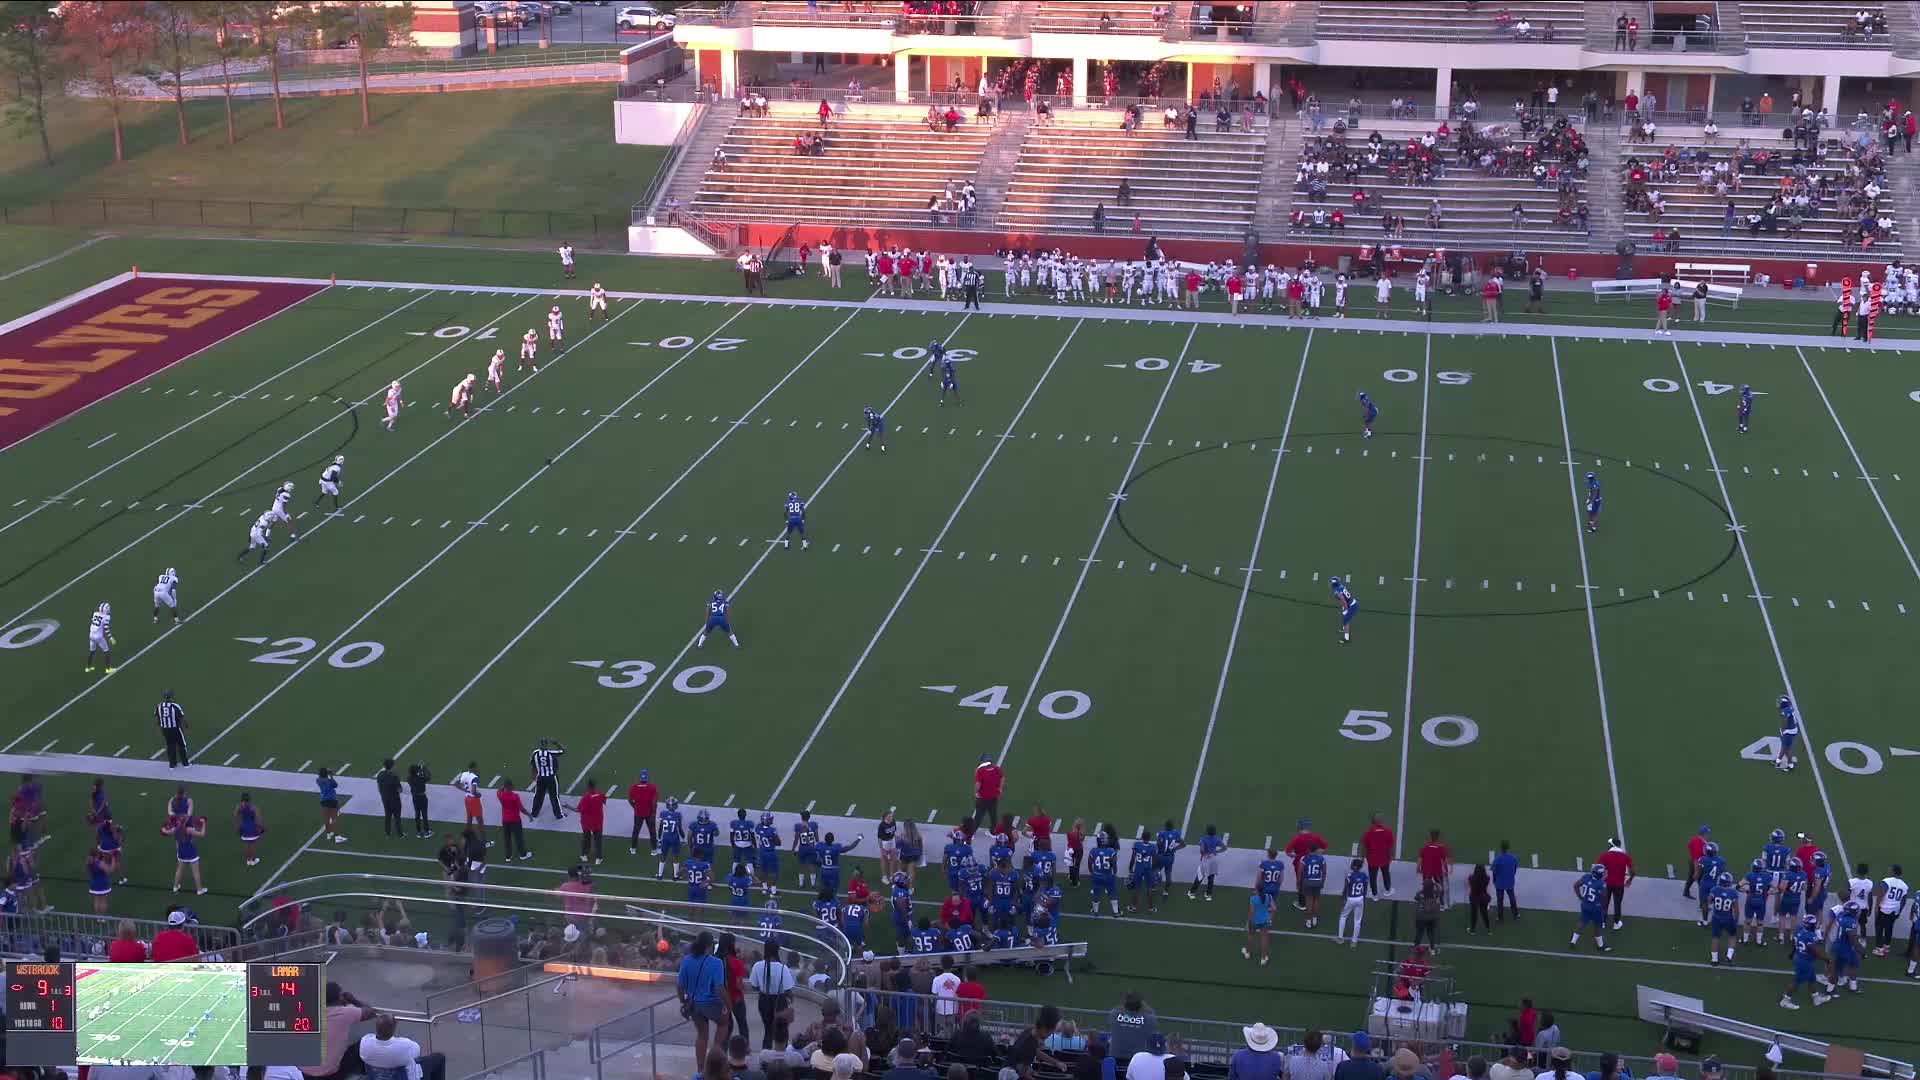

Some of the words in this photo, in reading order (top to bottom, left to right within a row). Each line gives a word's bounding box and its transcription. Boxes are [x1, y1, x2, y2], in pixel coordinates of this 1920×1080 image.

[0, 287, 261, 416] OLVES
[788, 502, 800, 513] 28
[711, 602, 725, 614] 54
[163, 707, 170, 717] B
[1339, 709, 1479, 747] 50
[540, 756, 547, 766] S
[662, 820, 676, 833] 27
[696, 833, 710, 844] 61
[824, 855, 833, 866] 6
[1094, 855, 1111, 869] 45
[1771, 854, 1781, 867] 11
[688, 870, 703, 884] 32
[1264, 870, 1280, 882] 30
[1709, 865, 1718, 880] 4
[1887, 886, 1904, 901] 50
[1714, 896, 1732, 912] 88
[821, 906, 837, 921] 20
[847, 905, 860, 917] 12
[914, 936, 933, 951] 95
[953, 934, 972, 951] 80
[1117, 1013, 1144, 1025] boost
